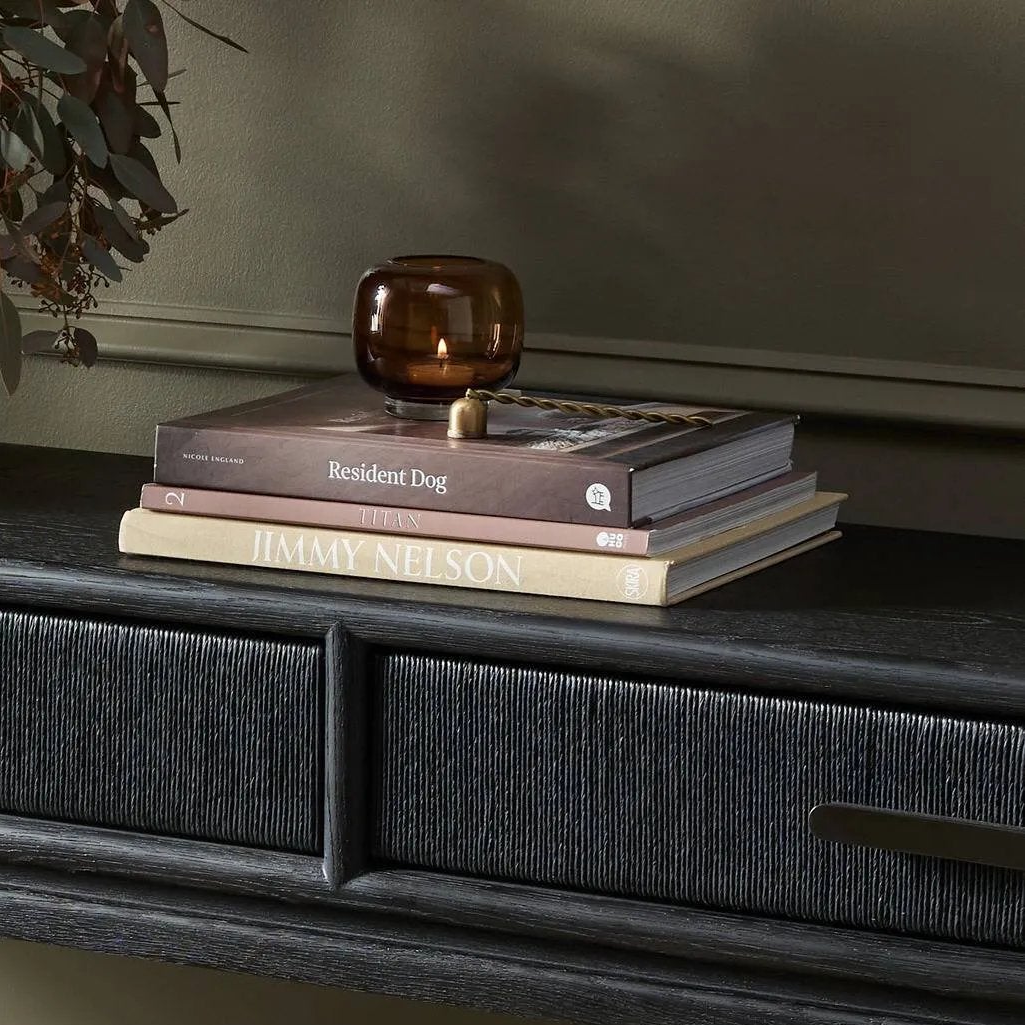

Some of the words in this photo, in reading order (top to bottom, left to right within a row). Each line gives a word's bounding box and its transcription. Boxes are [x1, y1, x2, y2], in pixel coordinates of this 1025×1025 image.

[183, 453, 208, 461] NICOLE
[211, 455, 244, 464] ENGLAND
[328, 461, 406, 486] Resident
[410, 468, 447, 494] Dog
[165, 492, 185, 506] 2
[359, 507, 421, 529] TITAN
[252, 530, 366, 570] JIMMY
[374, 542, 523, 586] NELSON
